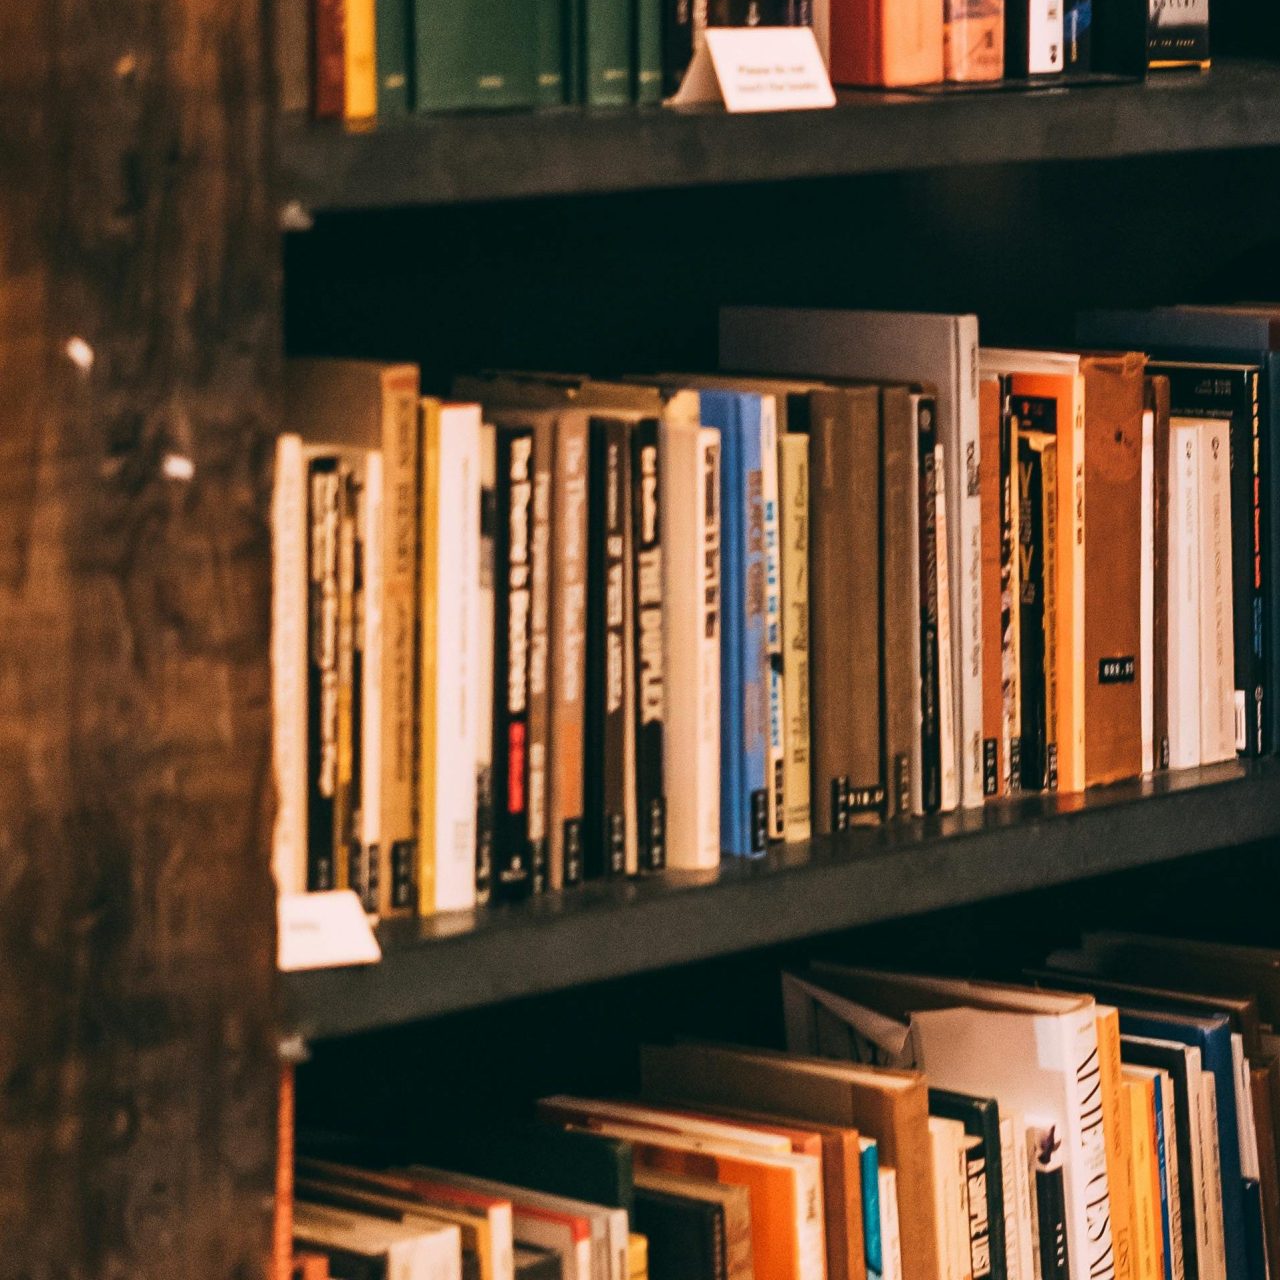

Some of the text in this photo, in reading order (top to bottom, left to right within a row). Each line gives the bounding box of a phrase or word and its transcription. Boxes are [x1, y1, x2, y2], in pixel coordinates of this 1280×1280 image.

[638, 544, 664, 726] THE DUPLEX
[969, 1172, 989, 1236] SIMPLE
[970, 1234, 992, 1278] LUST
